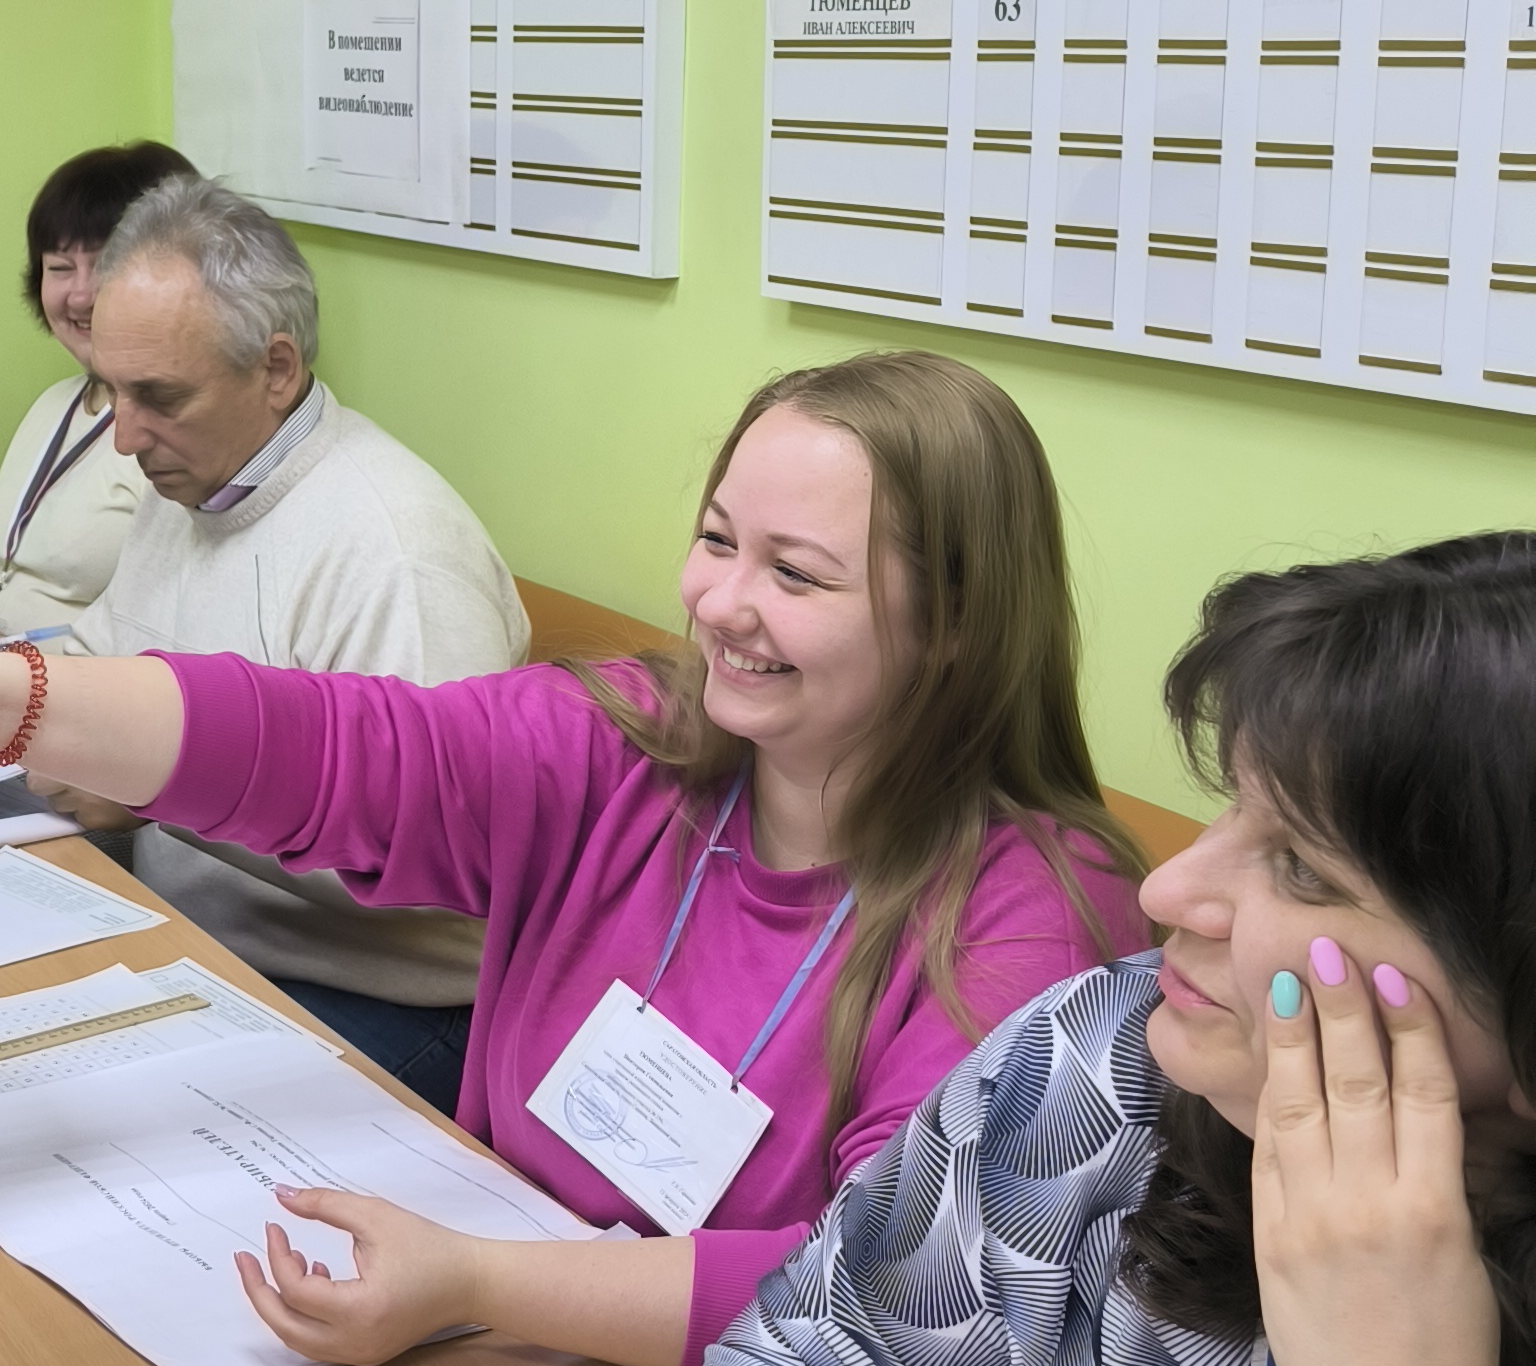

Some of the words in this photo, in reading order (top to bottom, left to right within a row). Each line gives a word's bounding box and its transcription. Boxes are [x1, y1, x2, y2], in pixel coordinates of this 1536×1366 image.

[803, 21, 832, 35] ИВАН
[835, 20, 915, 35] АЛЕКСЕЕВИЧ
[328, 30, 336, 50] В
[338, 35, 402, 52] помещении
[344, 67, 384, 83] ведется
[318, 94, 414, 118] видеонаблюдение
[192, 1127, 276, 1192] ЗБИРАТЕЛЕЙ
